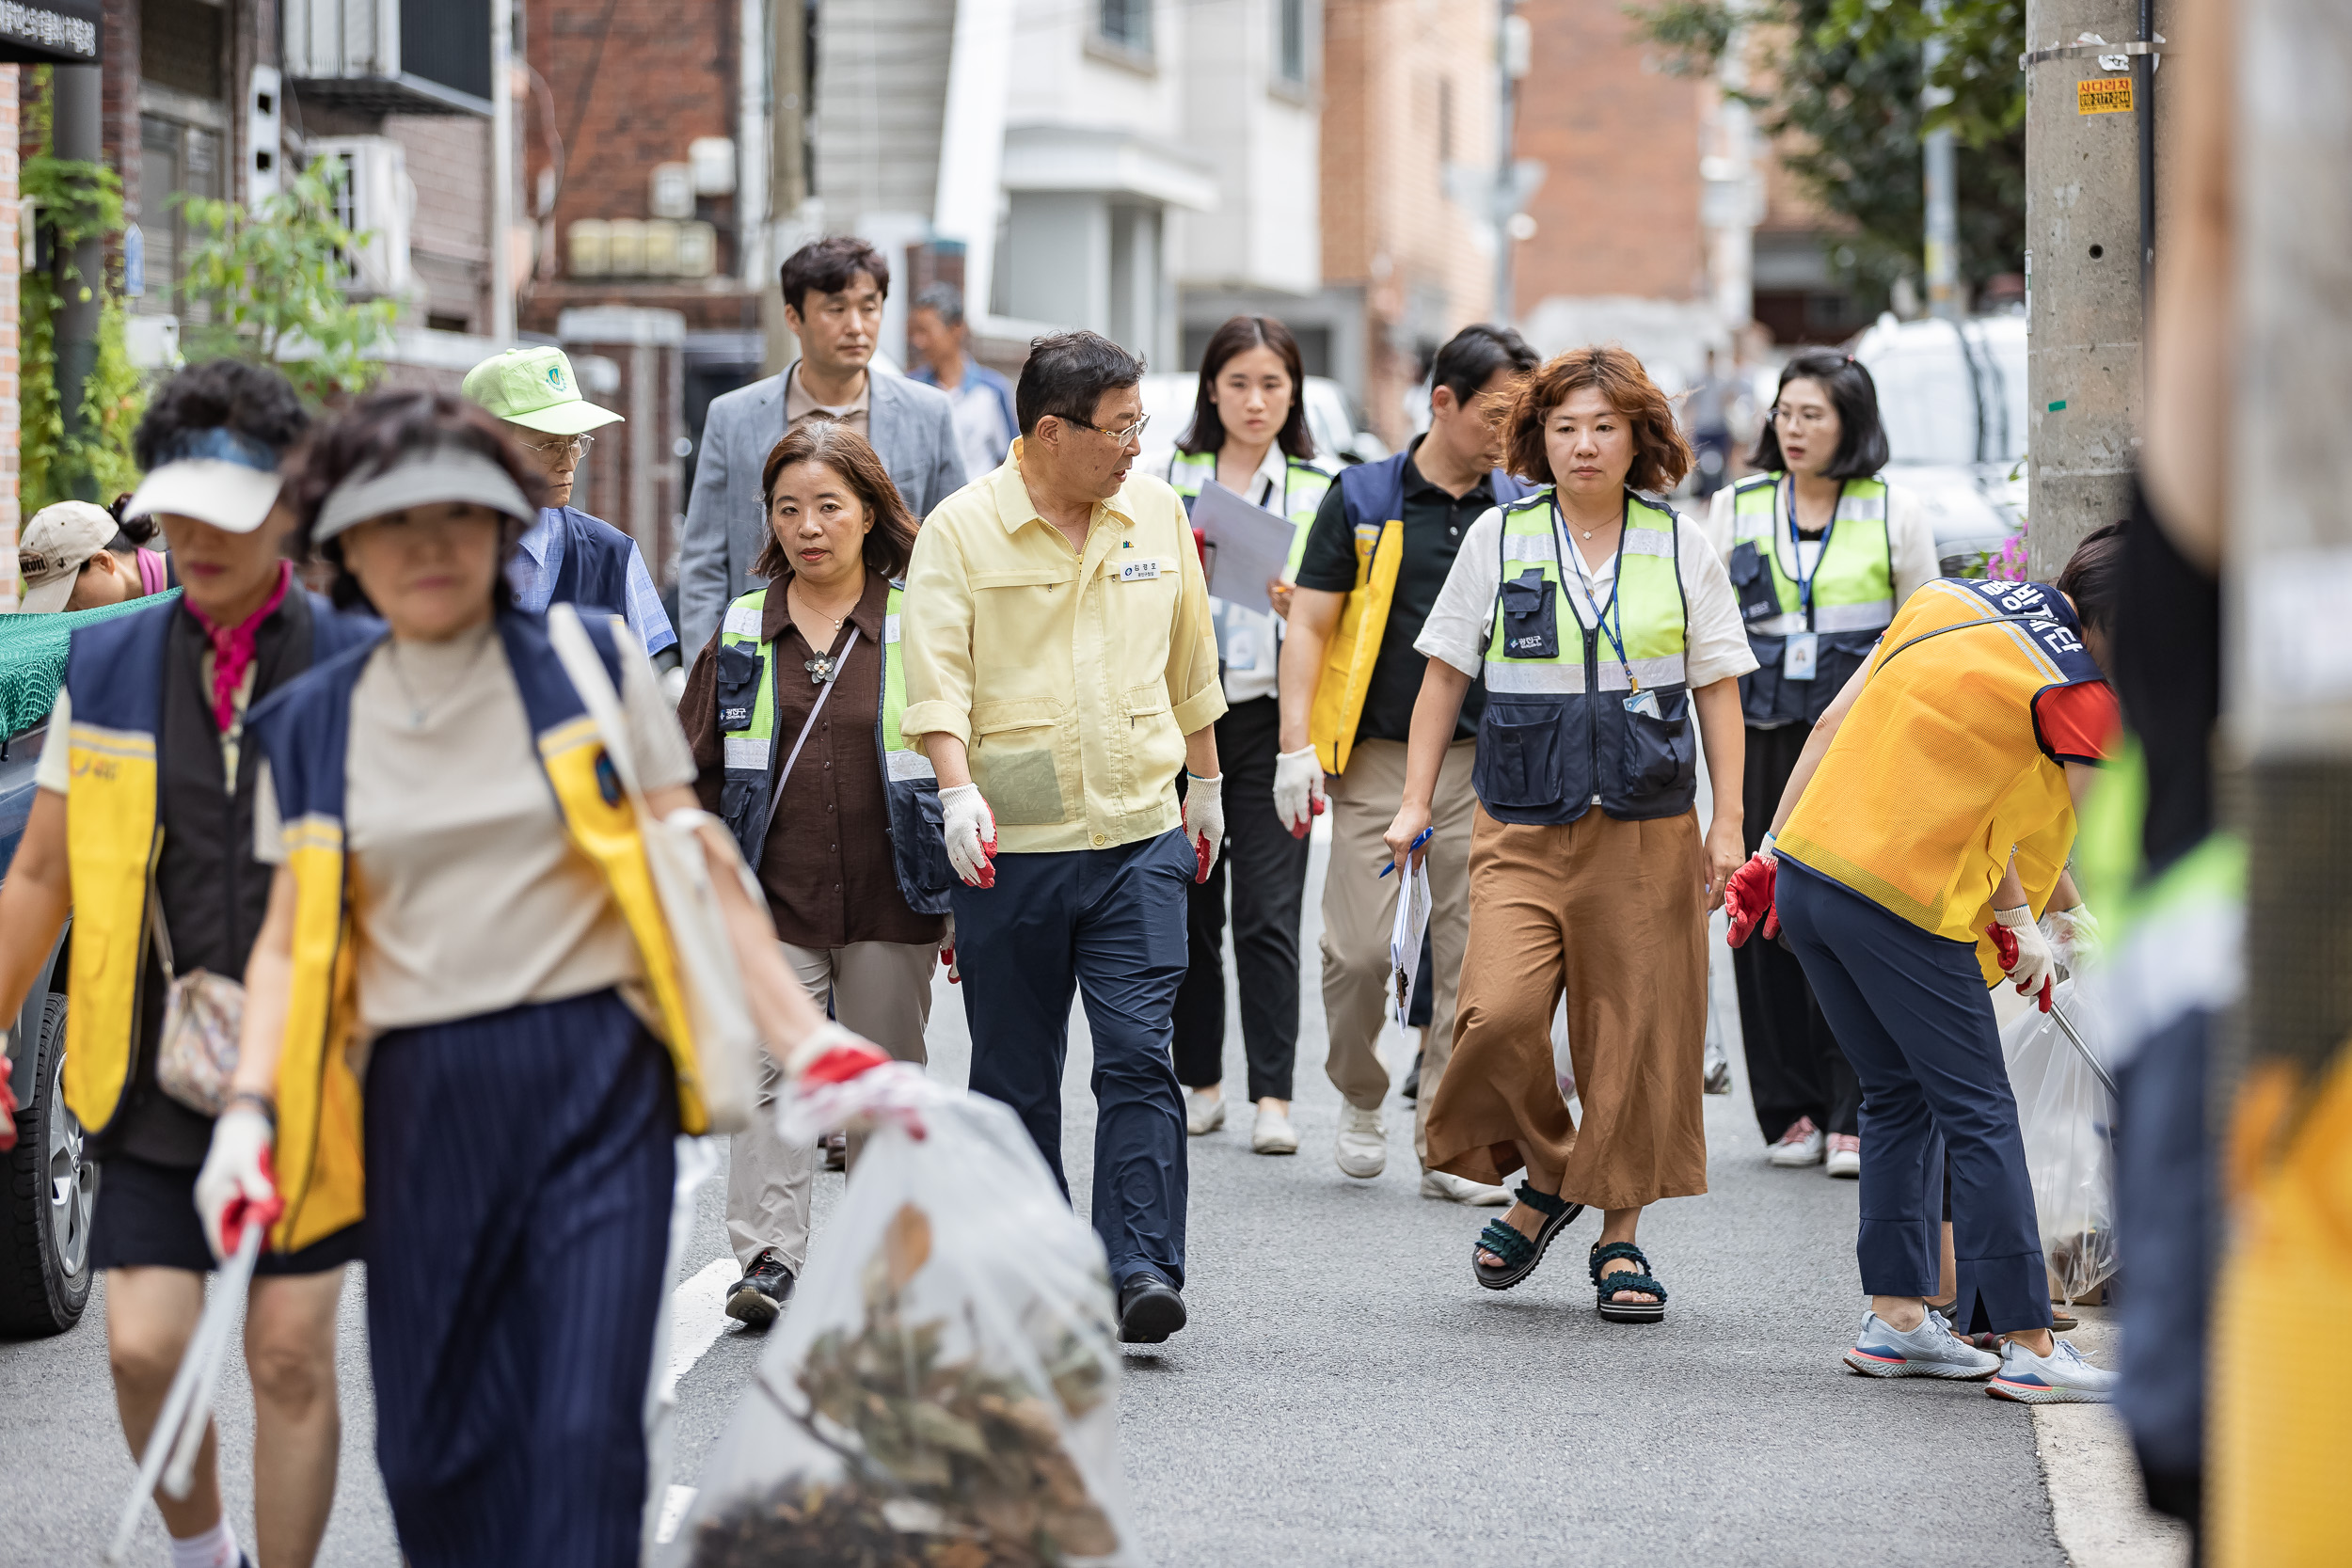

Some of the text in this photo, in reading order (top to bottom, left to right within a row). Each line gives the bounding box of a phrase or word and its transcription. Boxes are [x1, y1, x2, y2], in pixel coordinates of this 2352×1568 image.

[2081, 79, 2129, 92] 사다리차
[1518, 636, 1542, 644] 광진구
[725, 707, 746, 716] 광진구
